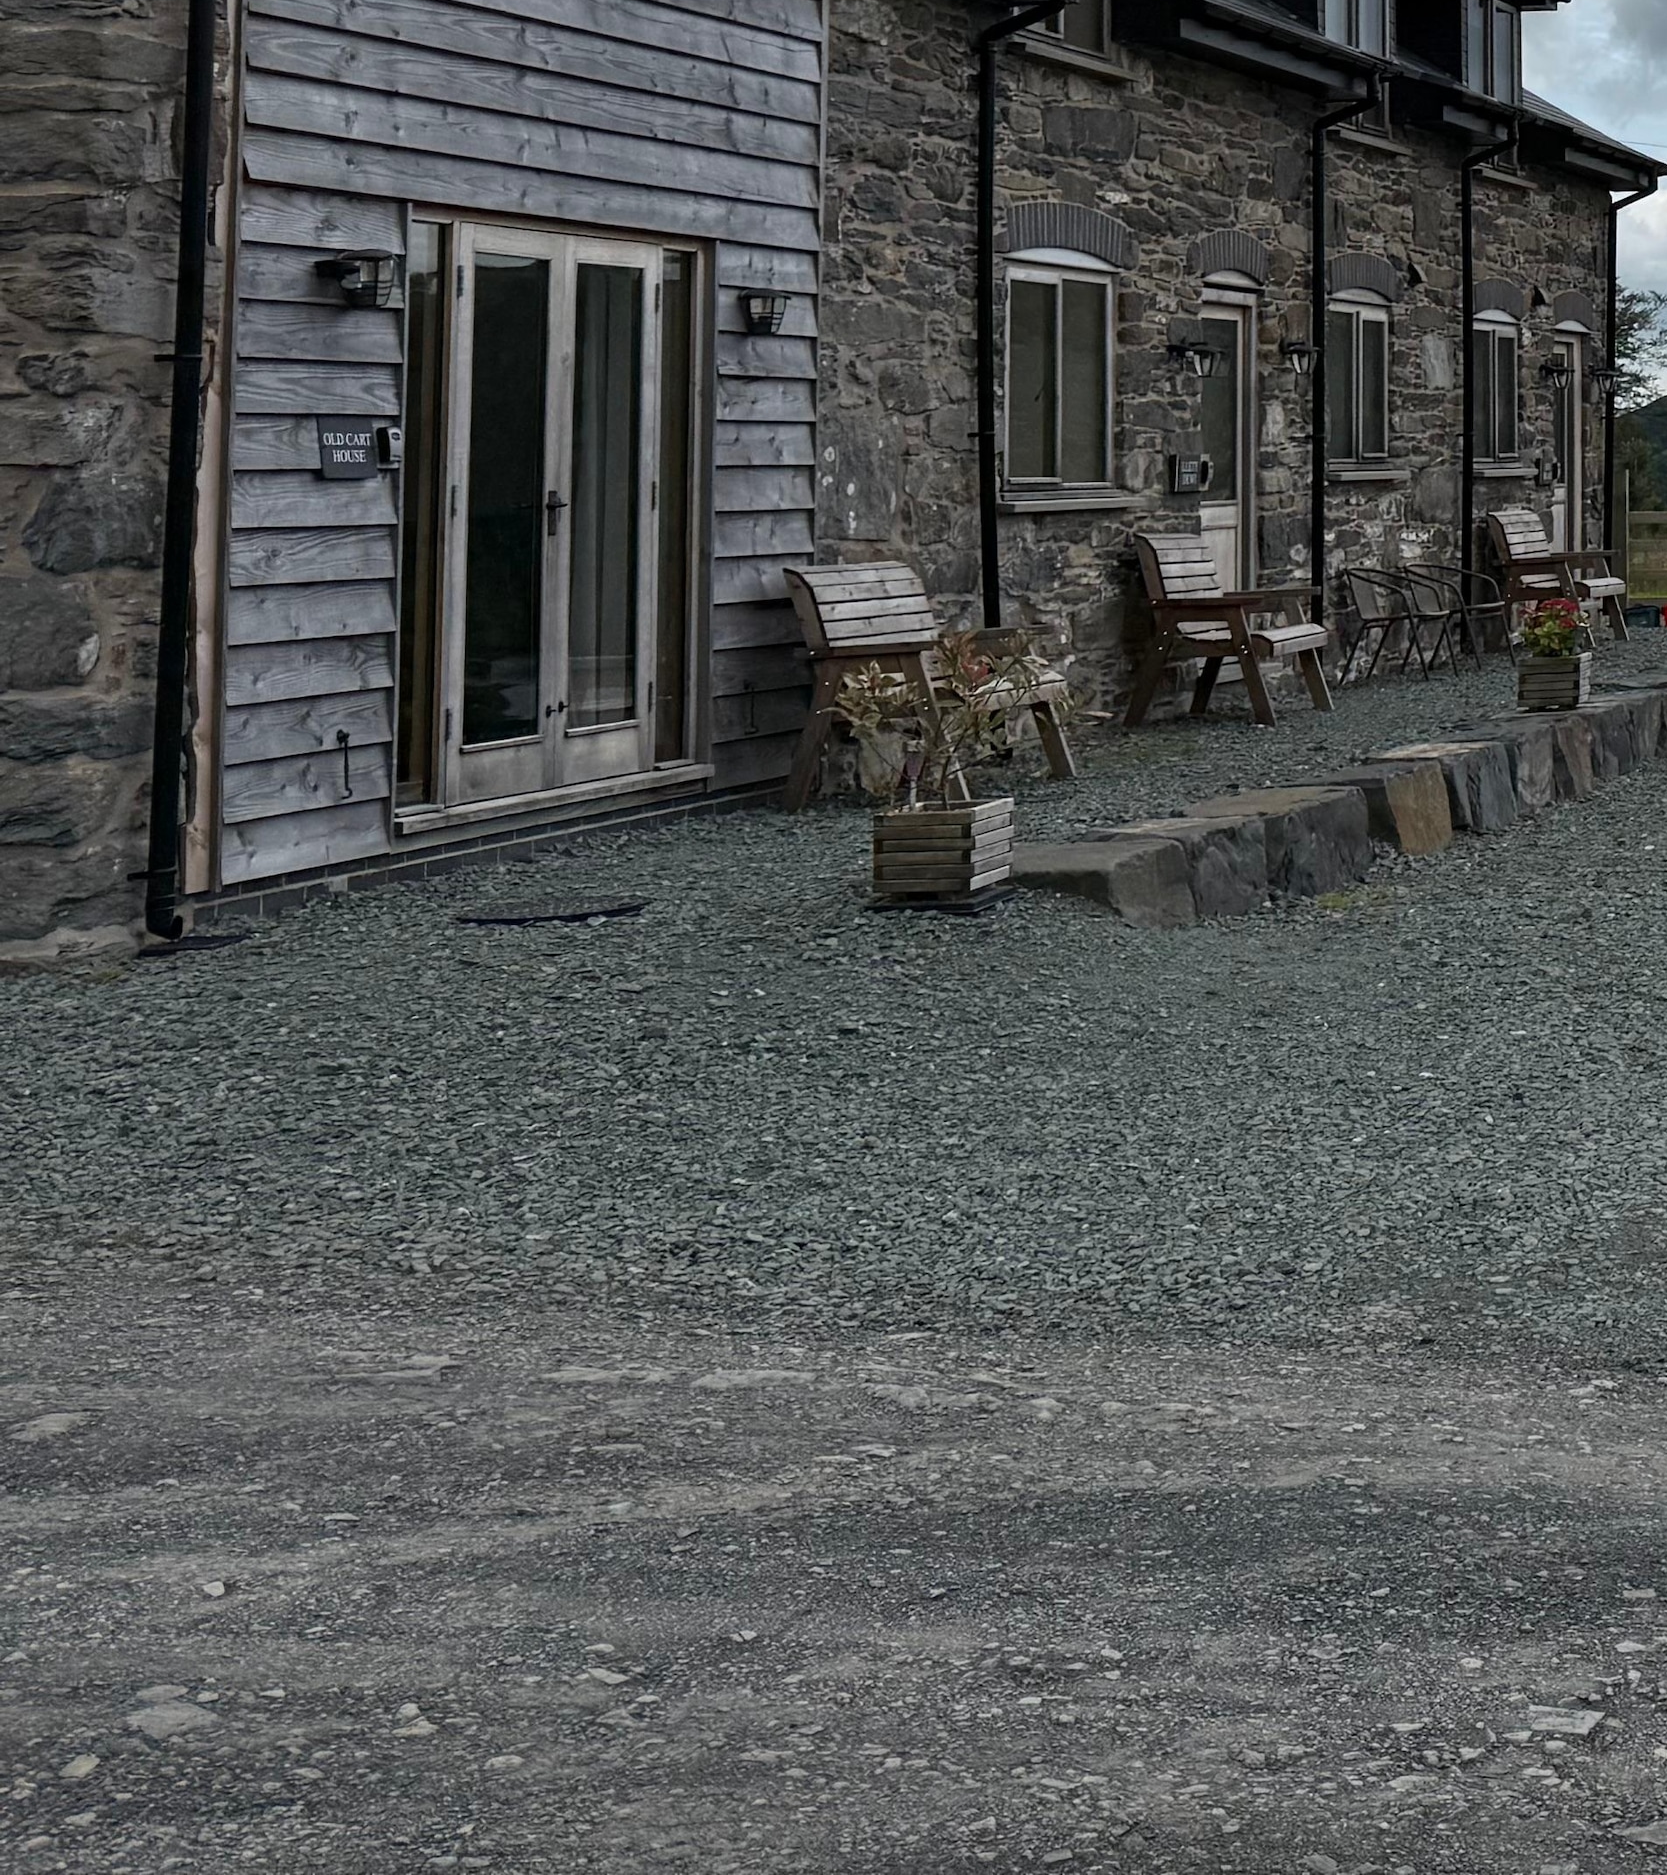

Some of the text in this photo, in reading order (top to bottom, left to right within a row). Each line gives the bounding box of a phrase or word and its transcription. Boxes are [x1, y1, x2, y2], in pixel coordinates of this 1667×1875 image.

[323, 432, 371, 446] OLD CART
[332, 449, 367, 462] HOUSE
